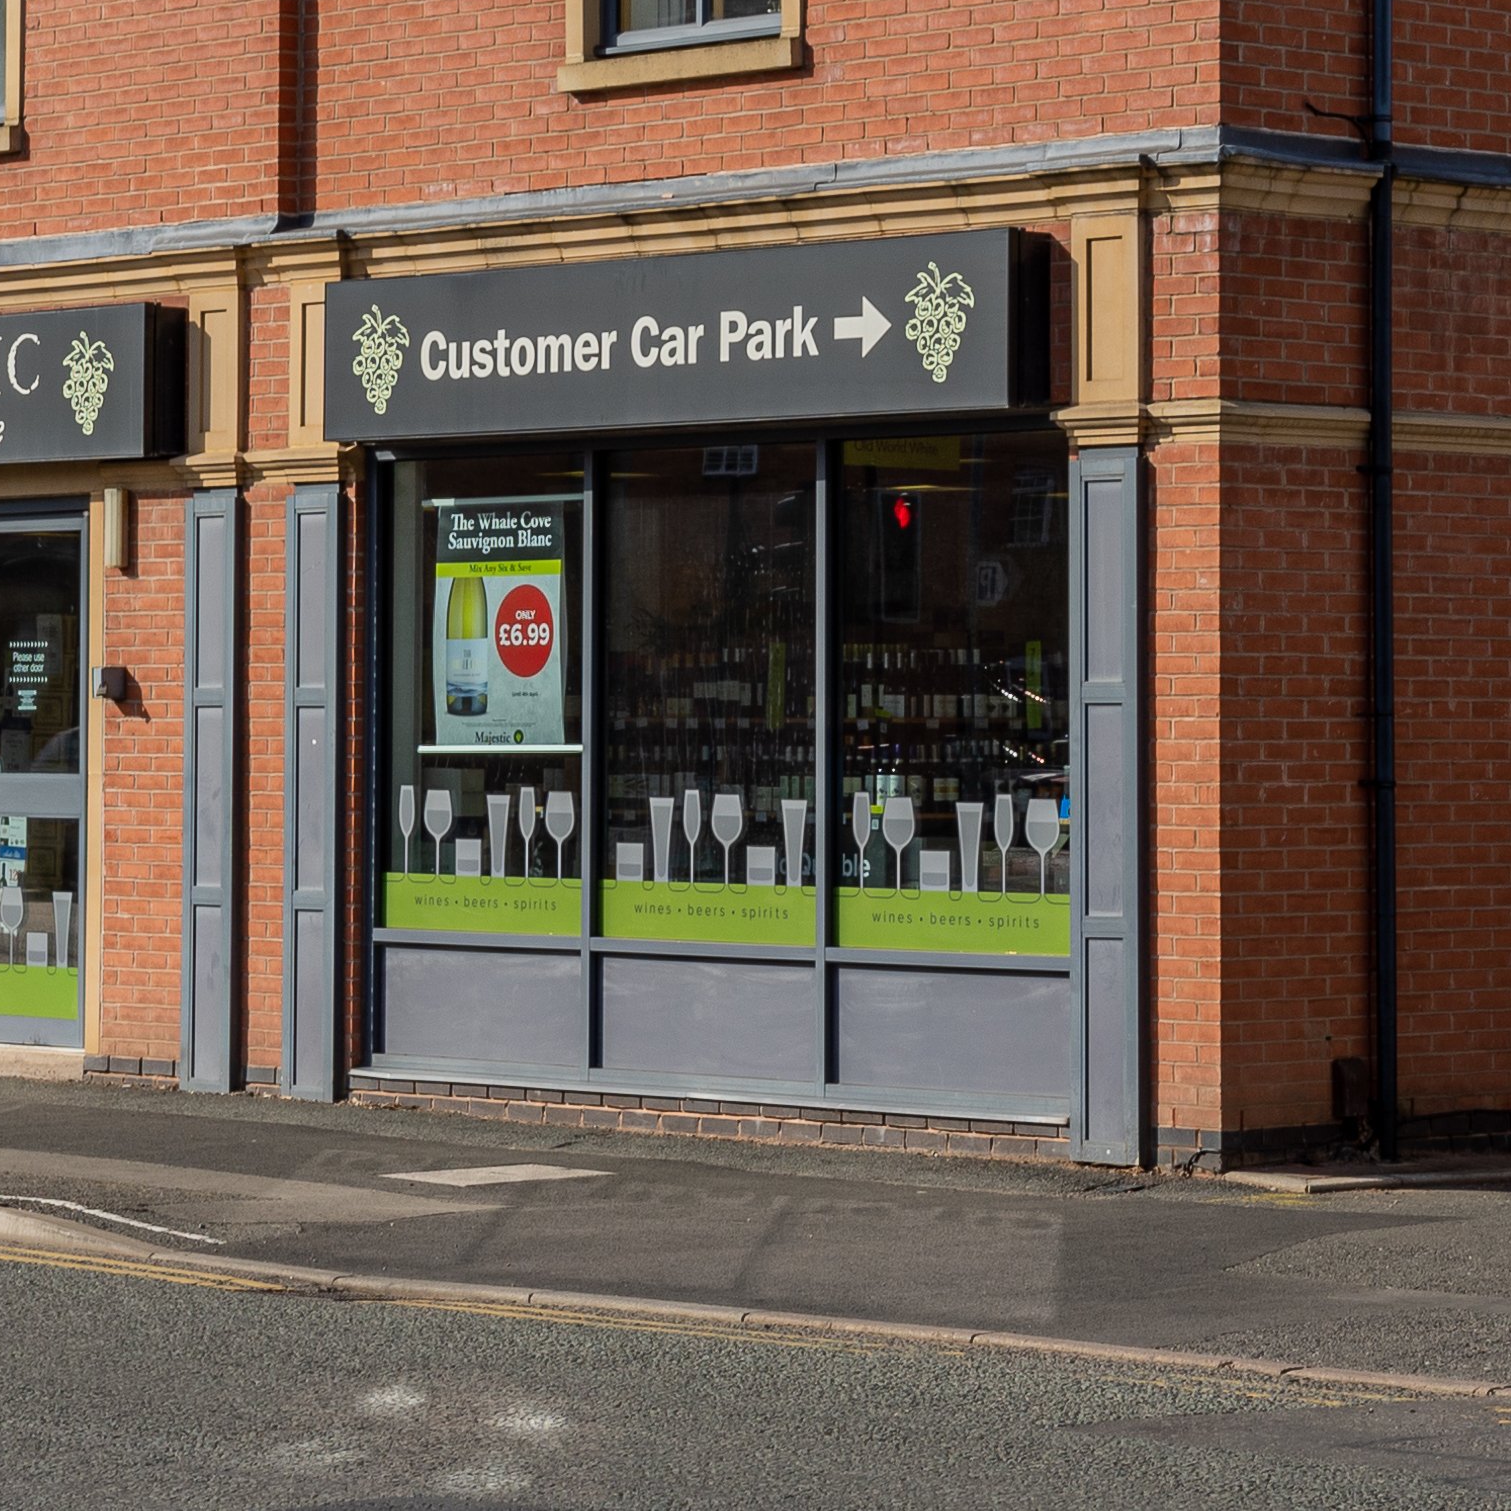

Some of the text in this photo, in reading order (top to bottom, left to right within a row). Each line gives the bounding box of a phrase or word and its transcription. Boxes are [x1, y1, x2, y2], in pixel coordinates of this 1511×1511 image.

[420, 305, 819, 381] Customer Car Park
[450, 511, 552, 531] The Whale Cove
[448, 530, 553, 554] Sauvignon Blanc
[515, 610, 536, 621] ONLY
[499, 623, 550, 646] £6.99
[13, 652, 45, 662] Please use
[475, 732, 511, 745] Majestic
[414, 895, 557, 912] wines beers spirits
[634, 903, 789, 921] wines beers spirits
[872, 911, 1040, 929] wines beers spirits
